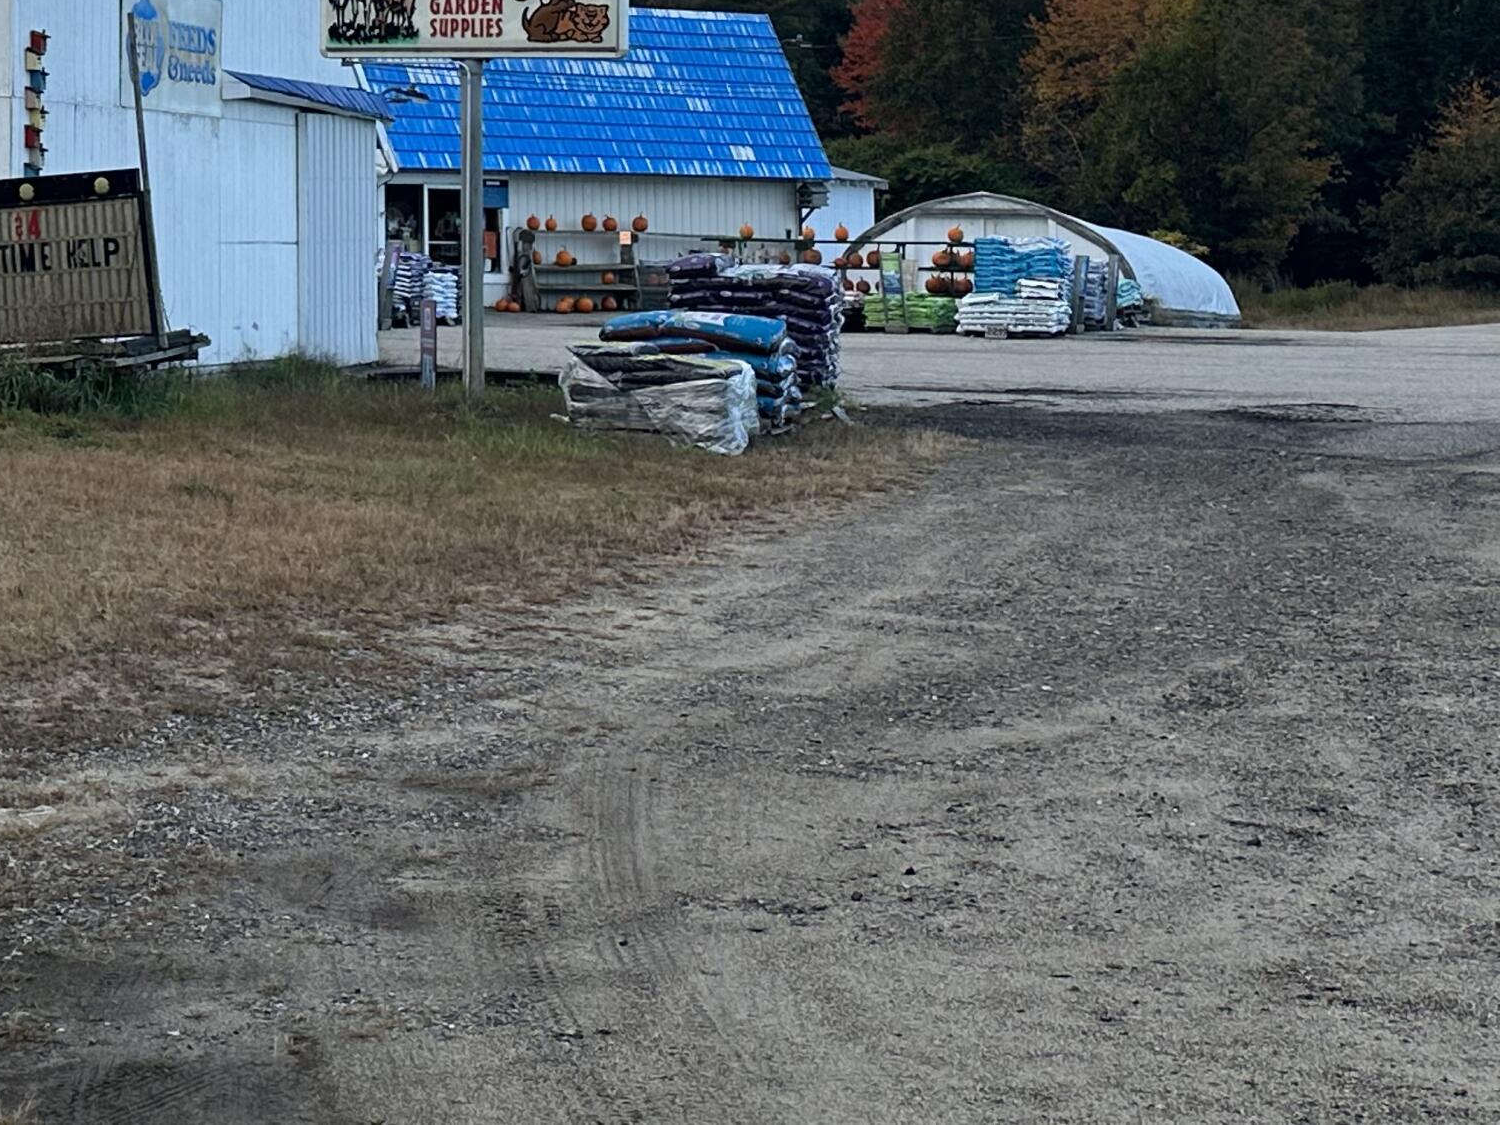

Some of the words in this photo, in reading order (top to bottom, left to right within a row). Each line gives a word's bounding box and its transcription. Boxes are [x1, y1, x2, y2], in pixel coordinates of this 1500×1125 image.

[169, 21, 217, 56] FEEDS
[430, 18, 503, 38] SUPPLIES
[0, 242, 52, 273] TIME
